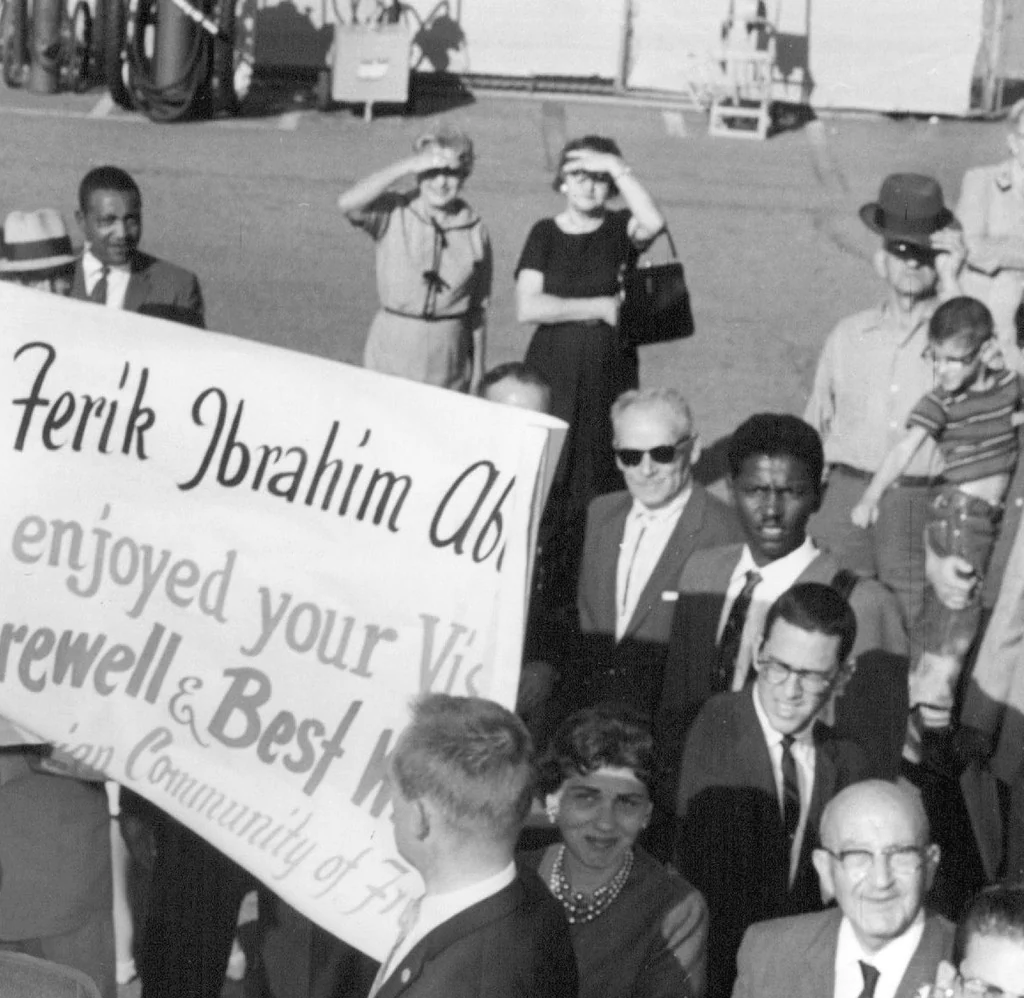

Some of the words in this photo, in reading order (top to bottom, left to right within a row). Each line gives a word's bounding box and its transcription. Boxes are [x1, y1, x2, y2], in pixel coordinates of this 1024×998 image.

[12, 341, 156, 460] Ferik
[177, 388, 413, 532] Ibrahim
[430, 460, 516, 573] Ab
[12, 503, 237, 624] enjoyed
[240, 586, 398, 678] your
[126, 726, 317, 880] Community
[311, 846, 374, 899] of
[168, 676, 210, 748] &
[207, 667, 363, 797] Best
